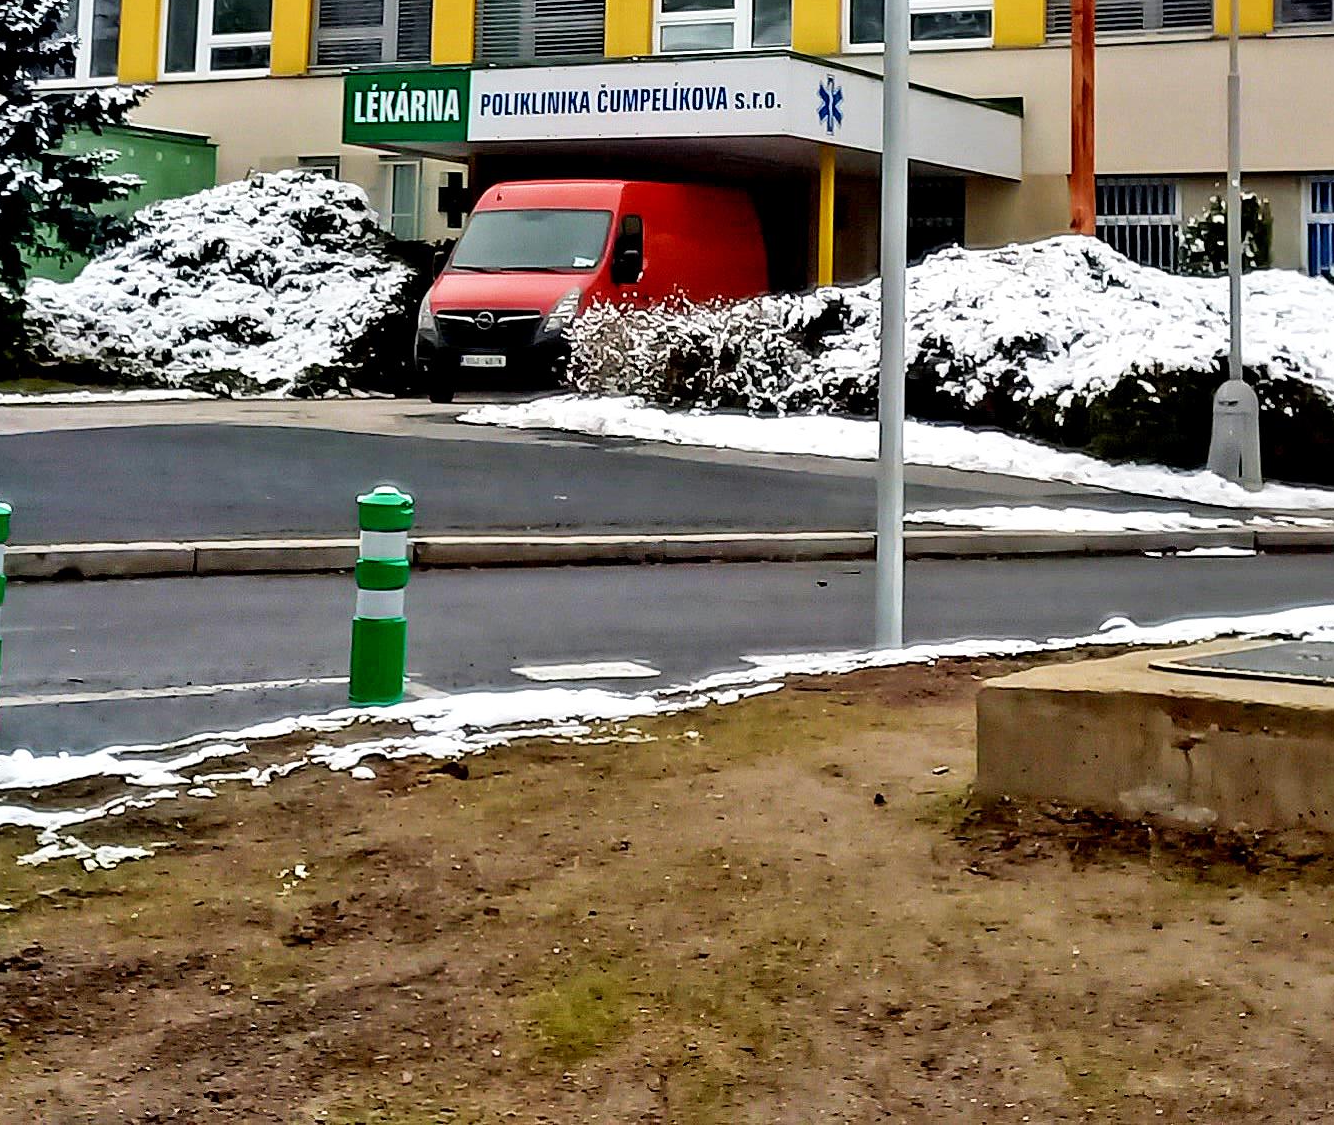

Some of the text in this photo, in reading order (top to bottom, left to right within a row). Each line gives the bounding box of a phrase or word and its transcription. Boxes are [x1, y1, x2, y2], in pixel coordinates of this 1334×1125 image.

[354, 82, 460, 123] LÉKÁRNA
[480, 81, 782, 116] POLIKLINIKA ČUMPELÍKOVA s.r.o.
